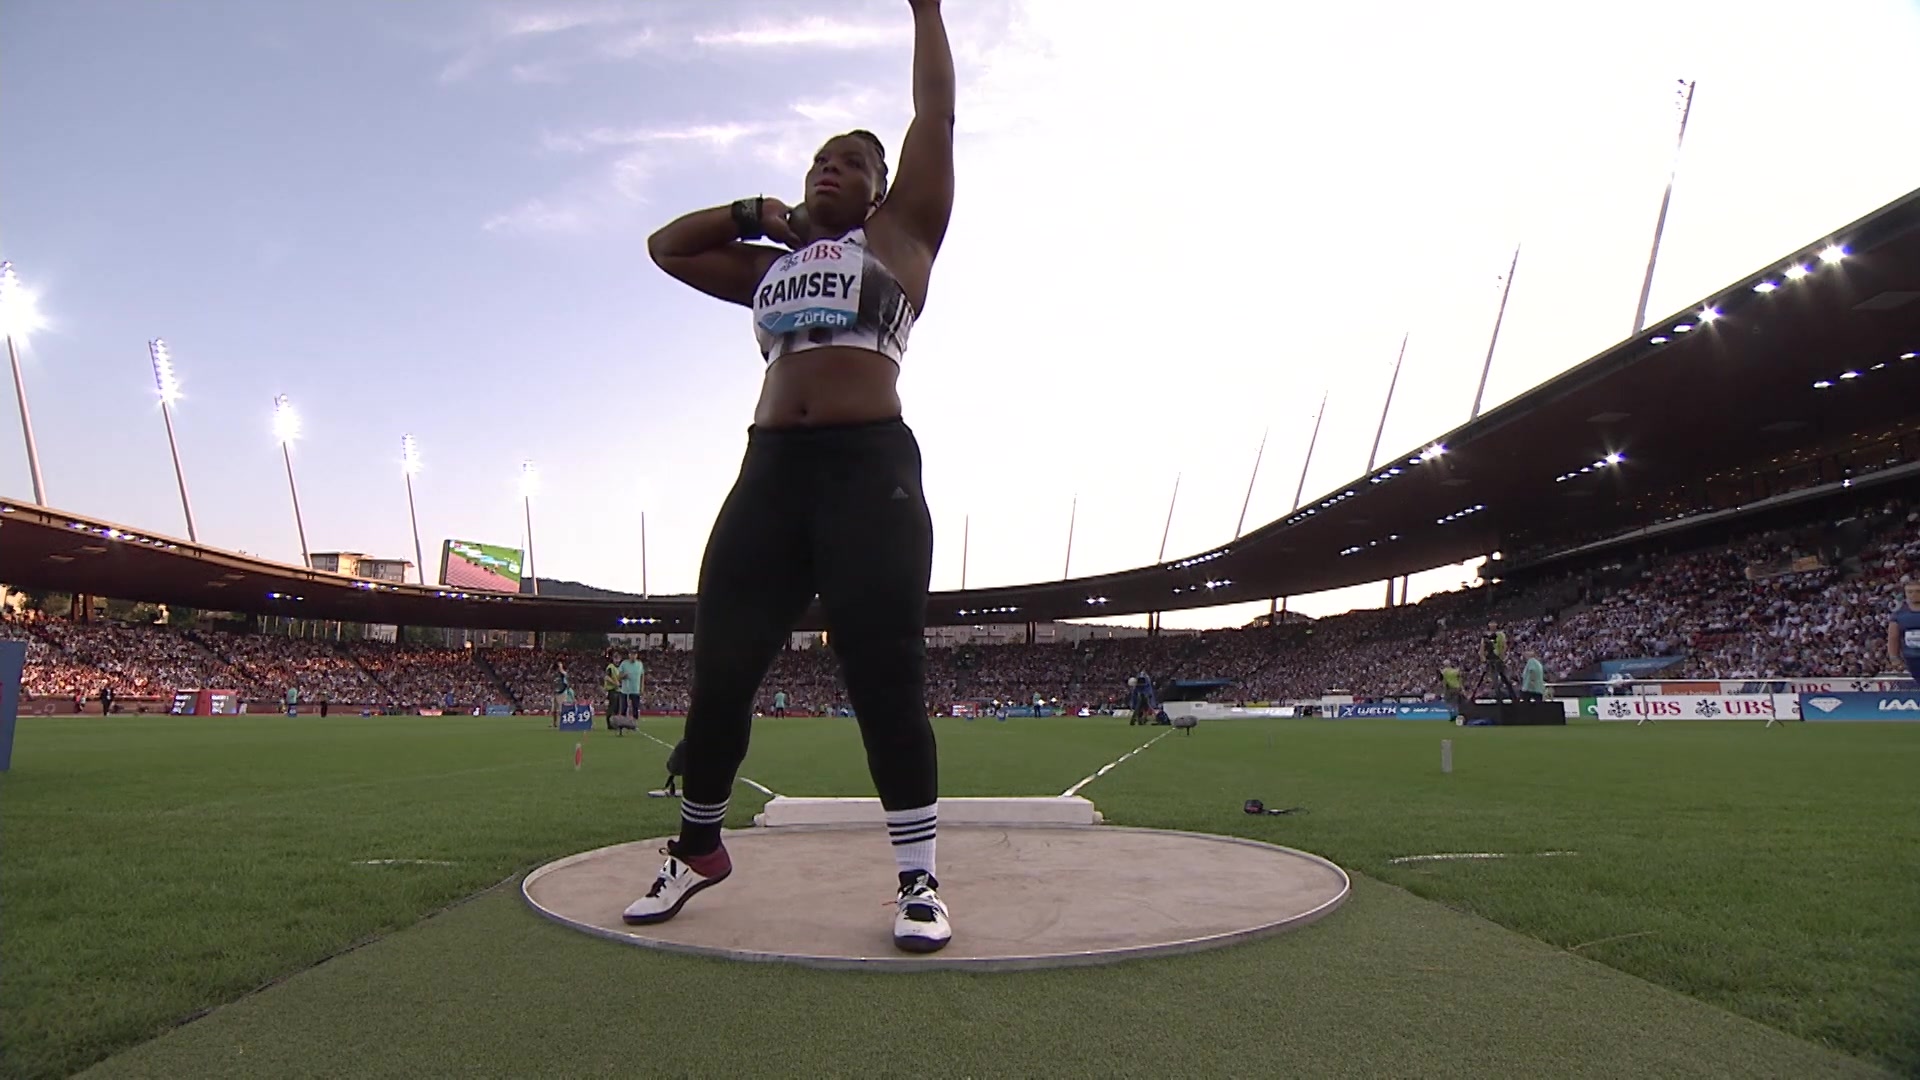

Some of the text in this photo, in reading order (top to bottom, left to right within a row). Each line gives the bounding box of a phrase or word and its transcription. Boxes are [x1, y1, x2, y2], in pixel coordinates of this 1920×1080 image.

[802, 244, 842, 263] UBS
[759, 272, 857, 309] RAMSEY
[794, 310, 848, 327] Zürich
[1633, 701, 1681, 715] UBS
[1724, 700, 1775, 715] UBS
[1878, 699, 1920, 710] IAA
[562, 711, 576, 724] 18
[578, 710, 590, 722] 19
